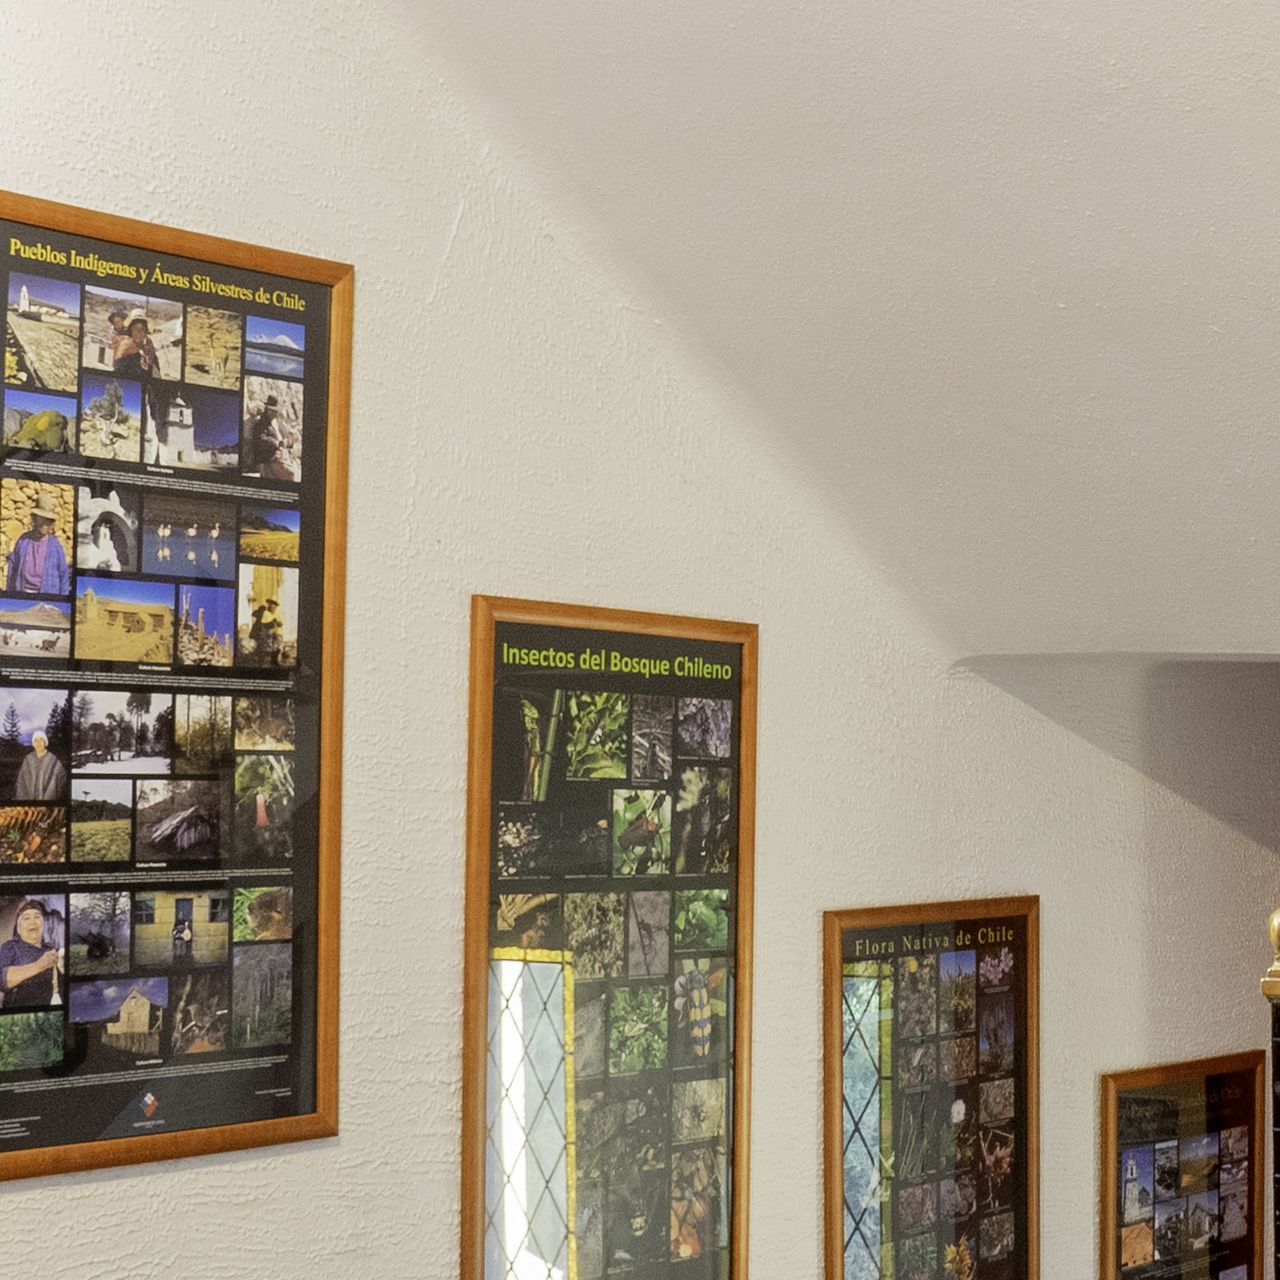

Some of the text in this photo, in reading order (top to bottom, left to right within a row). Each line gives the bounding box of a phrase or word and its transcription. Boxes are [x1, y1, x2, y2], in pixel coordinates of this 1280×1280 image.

[9, 238, 67, 266] Pueblos
[138, 268, 149, 284] y
[150, 262, 191, 289] Áreas
[192, 274, 253, 301] Silvestres
[255, 287, 271, 305] de
[272, 290, 306, 312] Chile
[502, 642, 732, 680] Insectos del Bosque Chileno
[855, 926, 1014, 956] Flora Nativa de Chile
